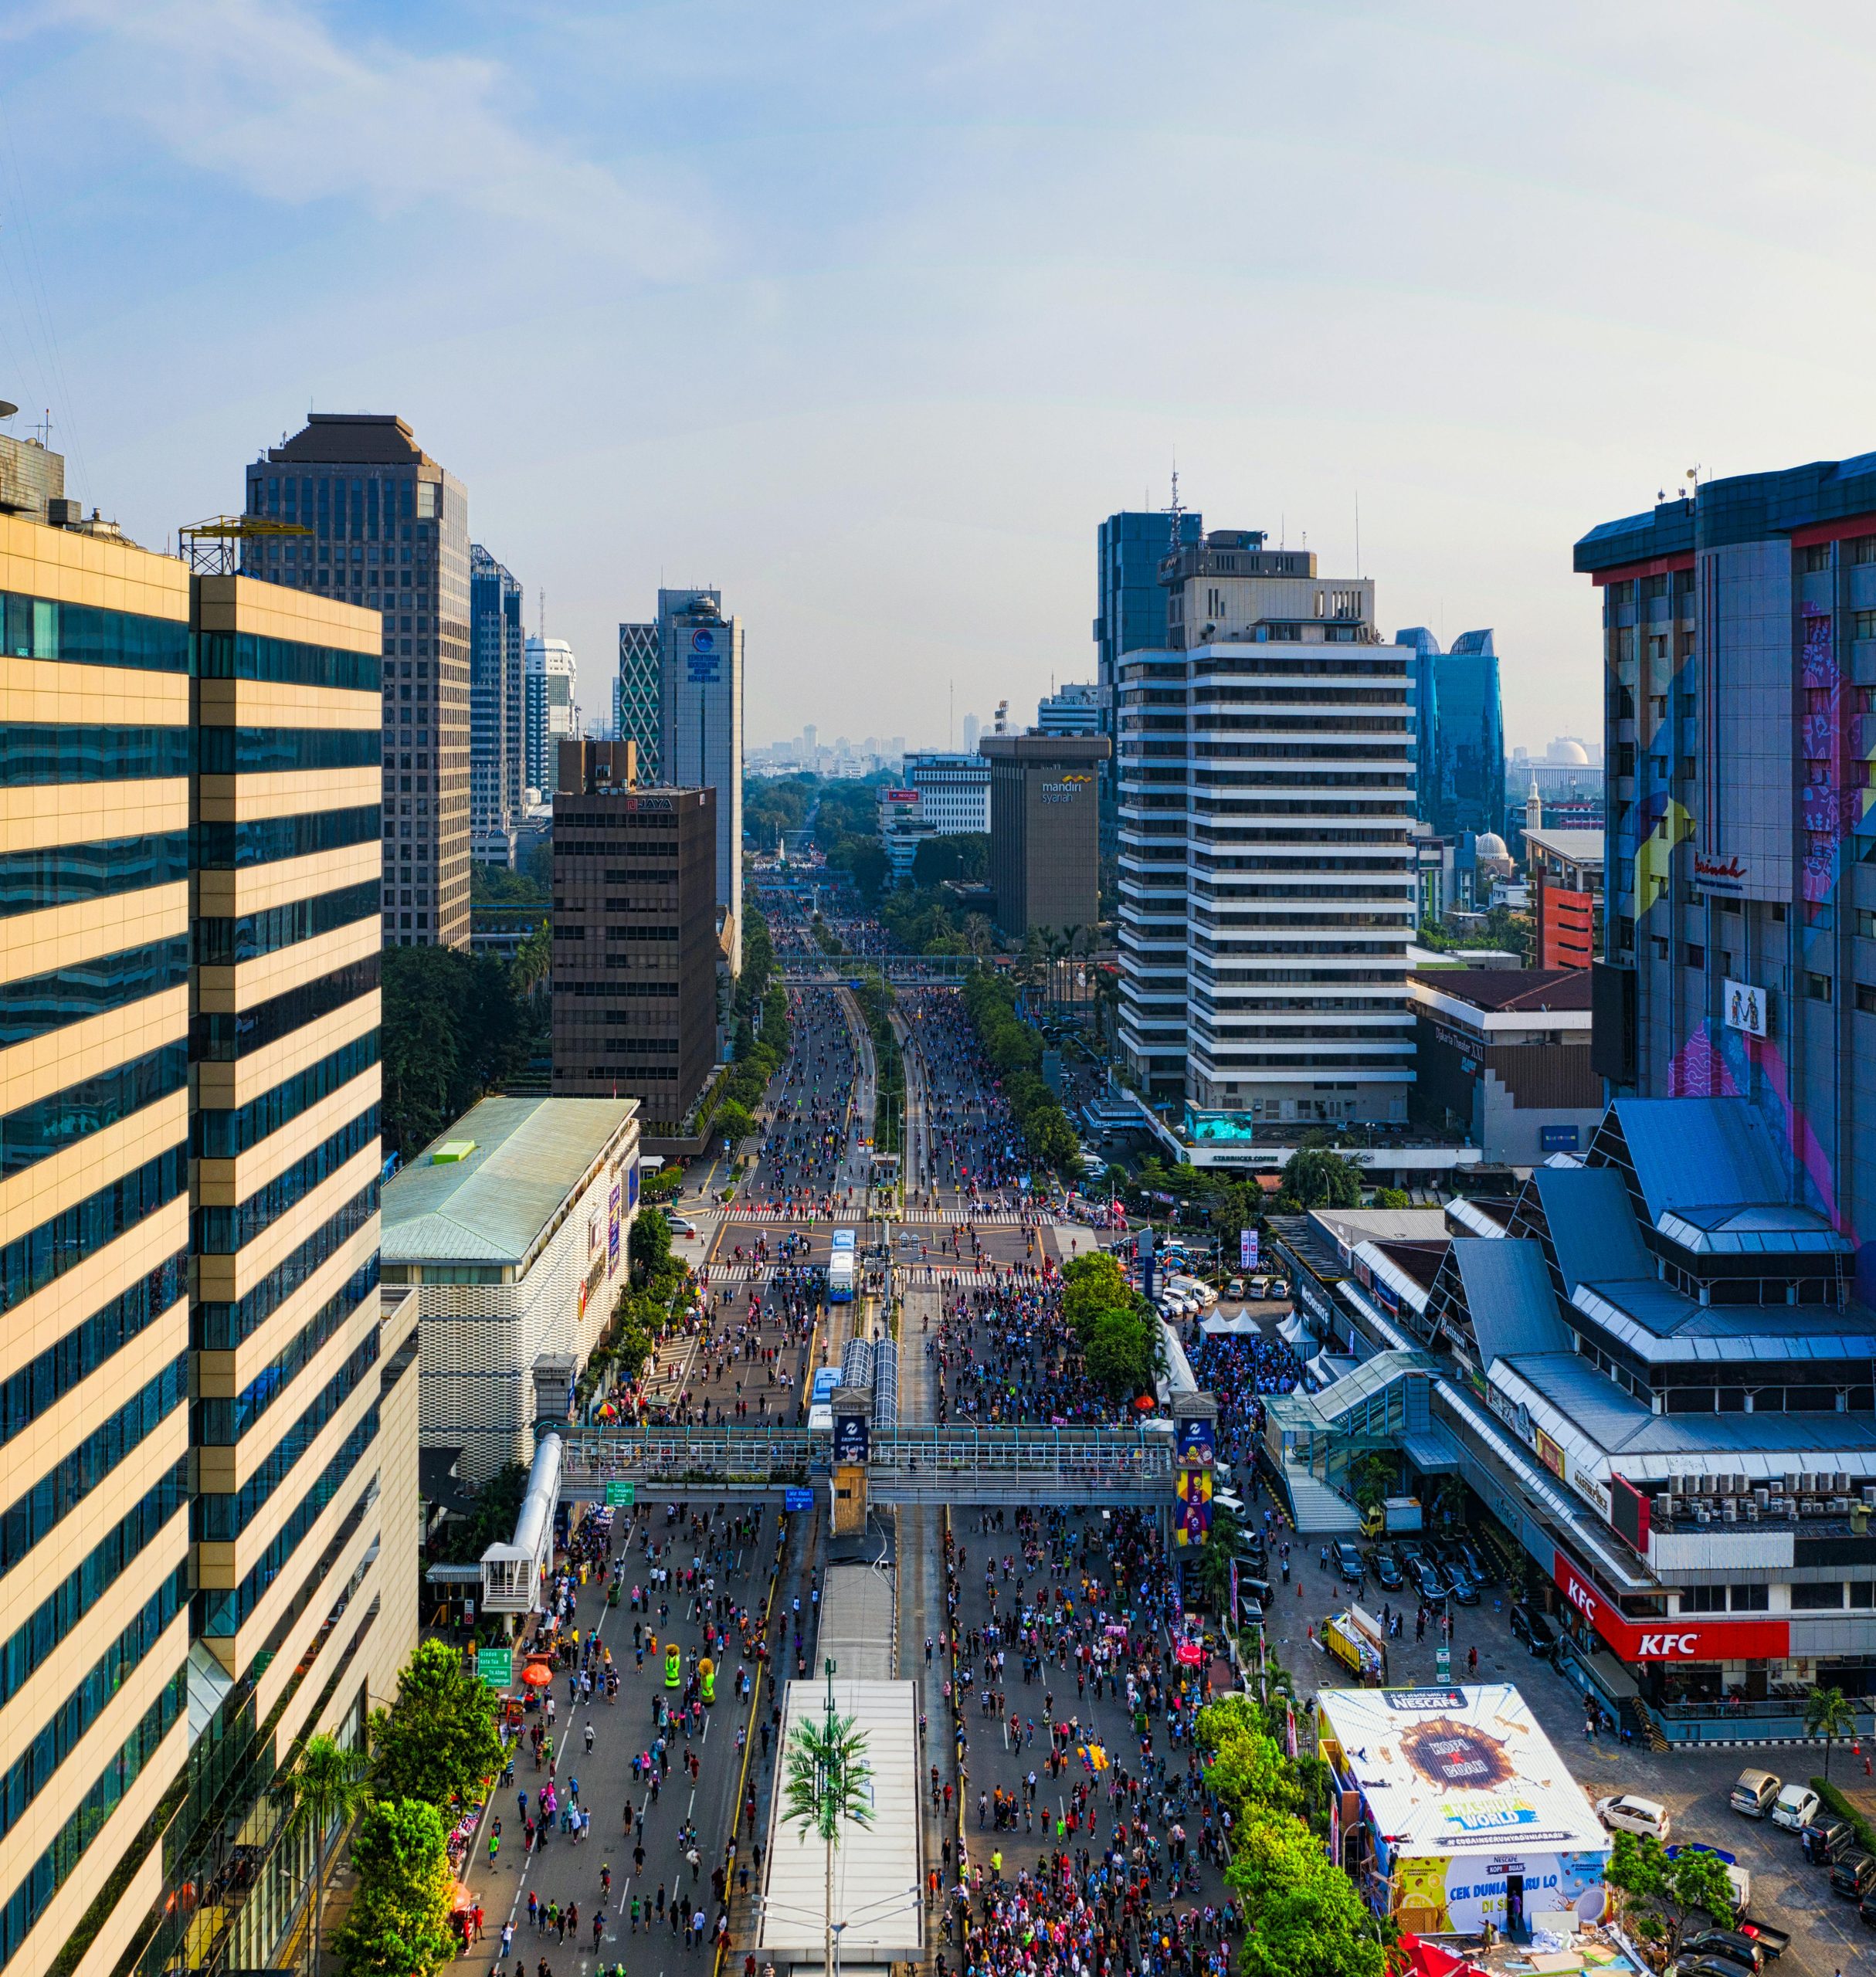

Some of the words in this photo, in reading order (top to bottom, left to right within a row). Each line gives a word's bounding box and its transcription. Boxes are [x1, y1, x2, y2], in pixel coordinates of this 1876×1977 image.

[1043, 781, 1081, 792] mandiri
[638, 799, 673, 809] JAYA
[1043, 792, 1073, 804] syariah
[1471, 1042, 1483, 1062] XXI
[1440, 1316, 1465, 1348] Platinum
[1567, 1577, 1596, 1621] KFC
[1637, 1633, 1698, 1656] KFC
[1429, 1738, 1471, 1755] KOPI
[1441, 1760, 1488, 1777] BUAH
[1450, 1799, 1517, 1816] MASHUP
[1461, 1811, 1520, 1829] WORLD
[1508, 1863, 1523, 1872] BUAH
[1450, 1885, 1471, 1901] CEK
[1473, 1880, 1507, 1897] DUNIA
[1522, 1877, 1540, 1891] ARU
[1543, 1874, 1557, 1888] LO
[1481, 1900, 1494, 1914] DI
